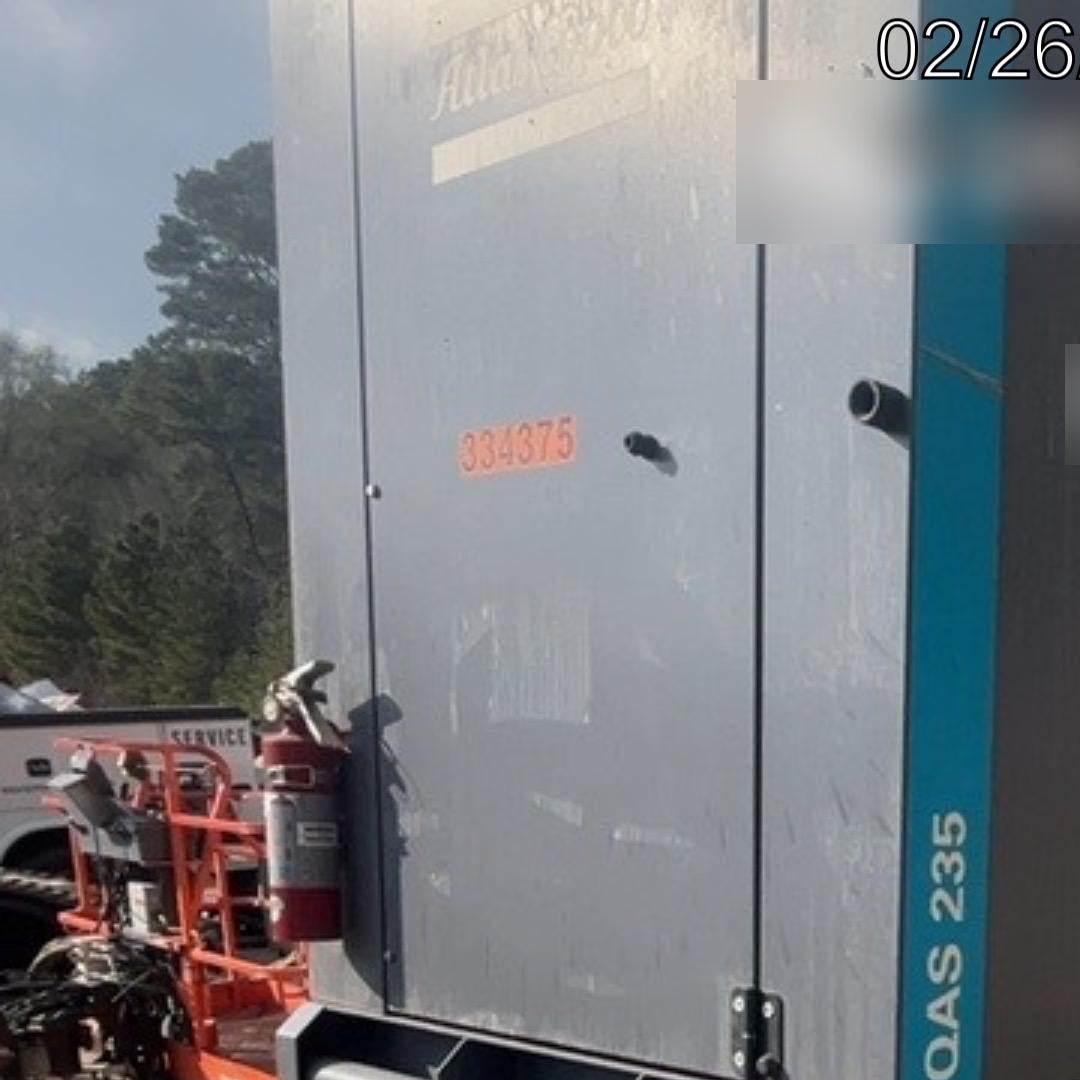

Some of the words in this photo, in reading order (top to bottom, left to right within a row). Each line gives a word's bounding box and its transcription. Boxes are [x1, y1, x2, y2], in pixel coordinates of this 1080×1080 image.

[461, 416, 573, 471] 334375
[170, 728, 247, 746] SERVICE
[930, 811, 967, 922] 235
